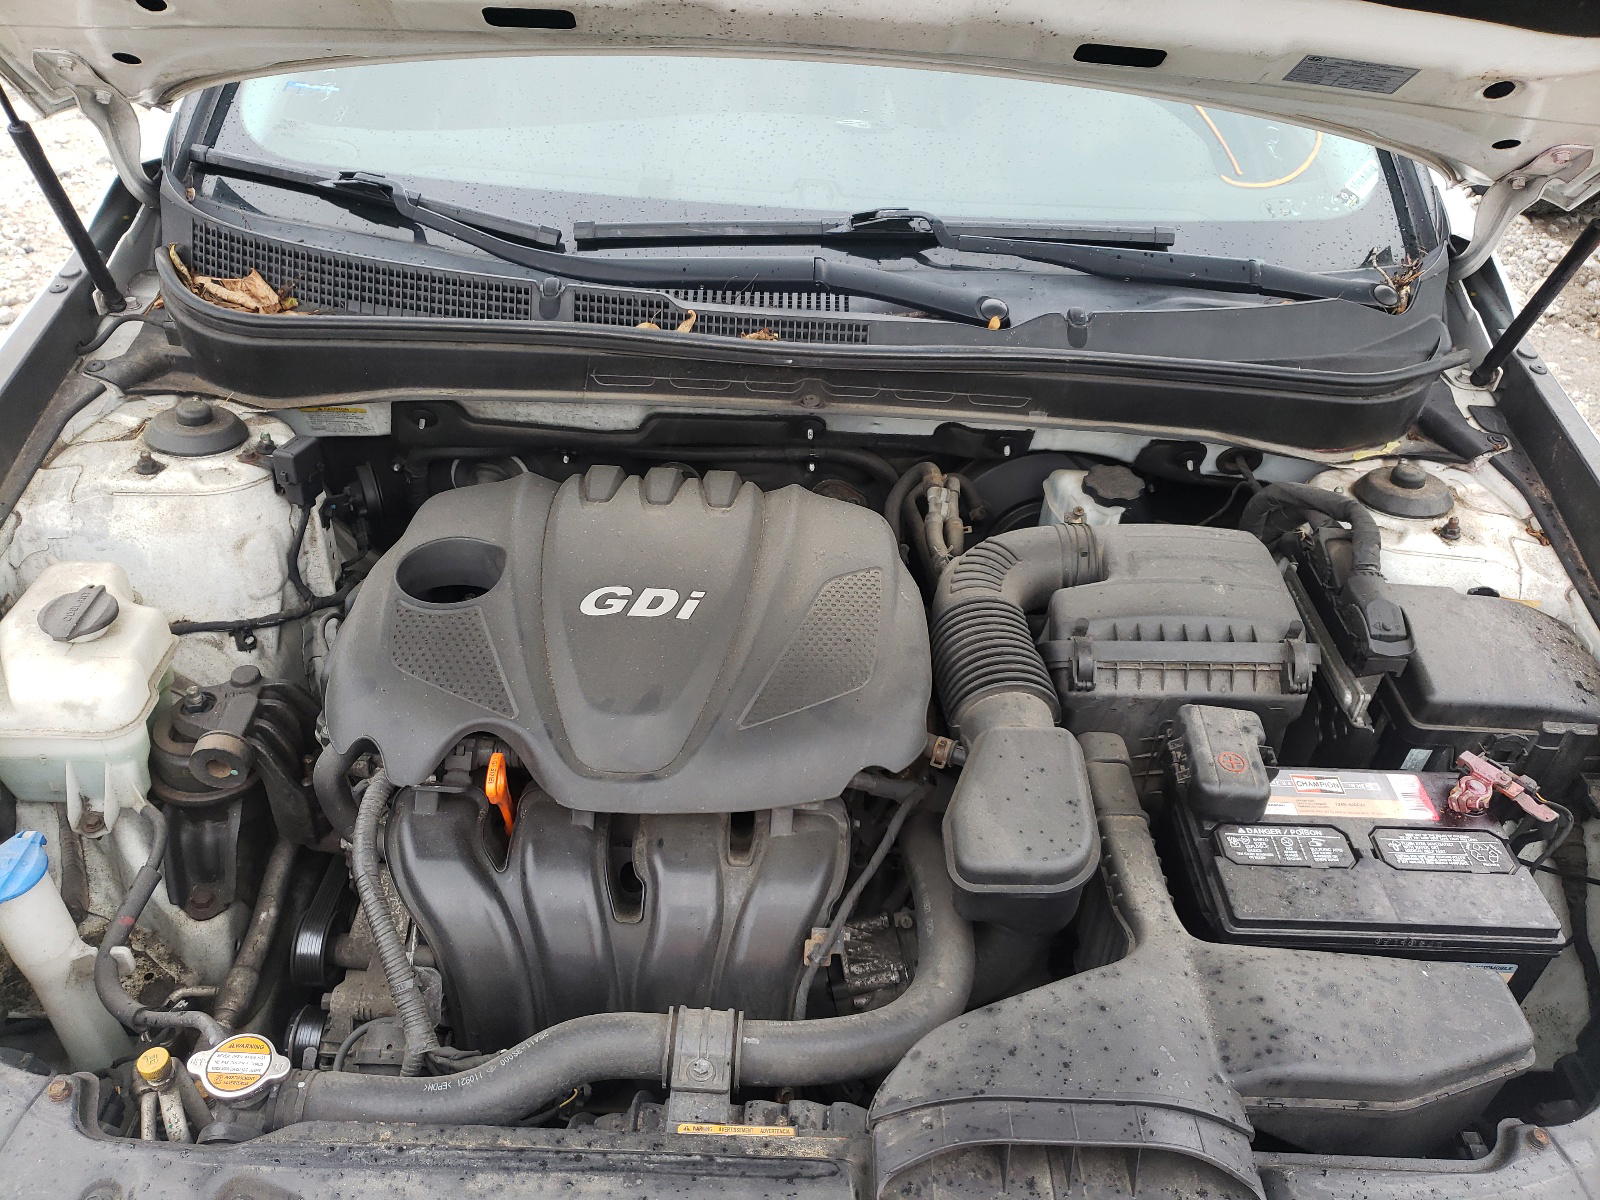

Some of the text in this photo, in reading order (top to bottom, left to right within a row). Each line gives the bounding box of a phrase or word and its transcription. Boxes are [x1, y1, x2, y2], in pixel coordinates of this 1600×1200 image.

[580, 586, 706, 620] GDi
[1296, 780, 1341, 789] CHAMPION
[1290, 829, 1323, 837] POISON
[457, 1073, 483, 1087] 110921
